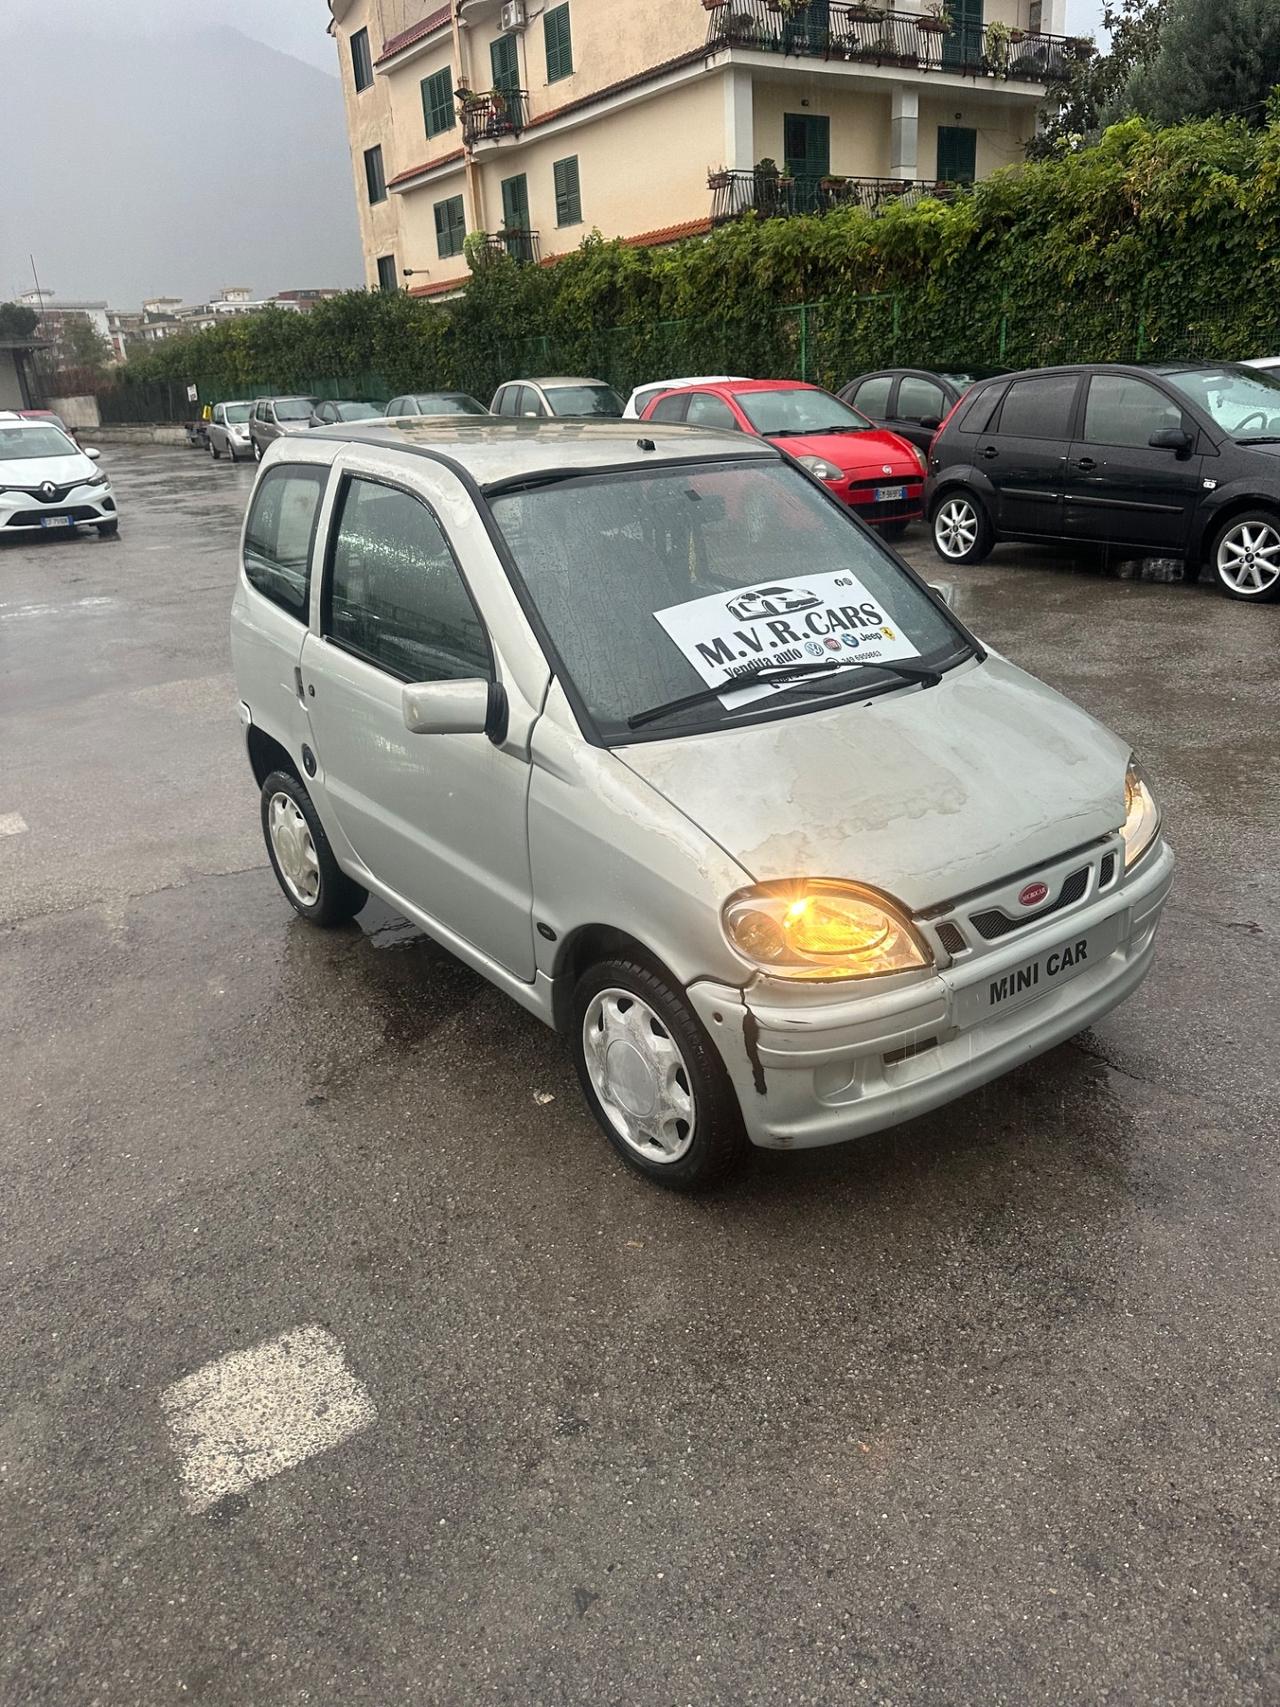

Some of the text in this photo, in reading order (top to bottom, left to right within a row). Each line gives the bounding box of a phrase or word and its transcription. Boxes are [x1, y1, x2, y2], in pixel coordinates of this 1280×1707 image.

[695, 602, 883, 668] M.V.R.CARS
[859, 632, 883, 642] Jeep
[723, 657, 774, 680] Vendita
[772, 647, 803, 665] auto
[989, 939, 1088, 1005] MINI CAR
